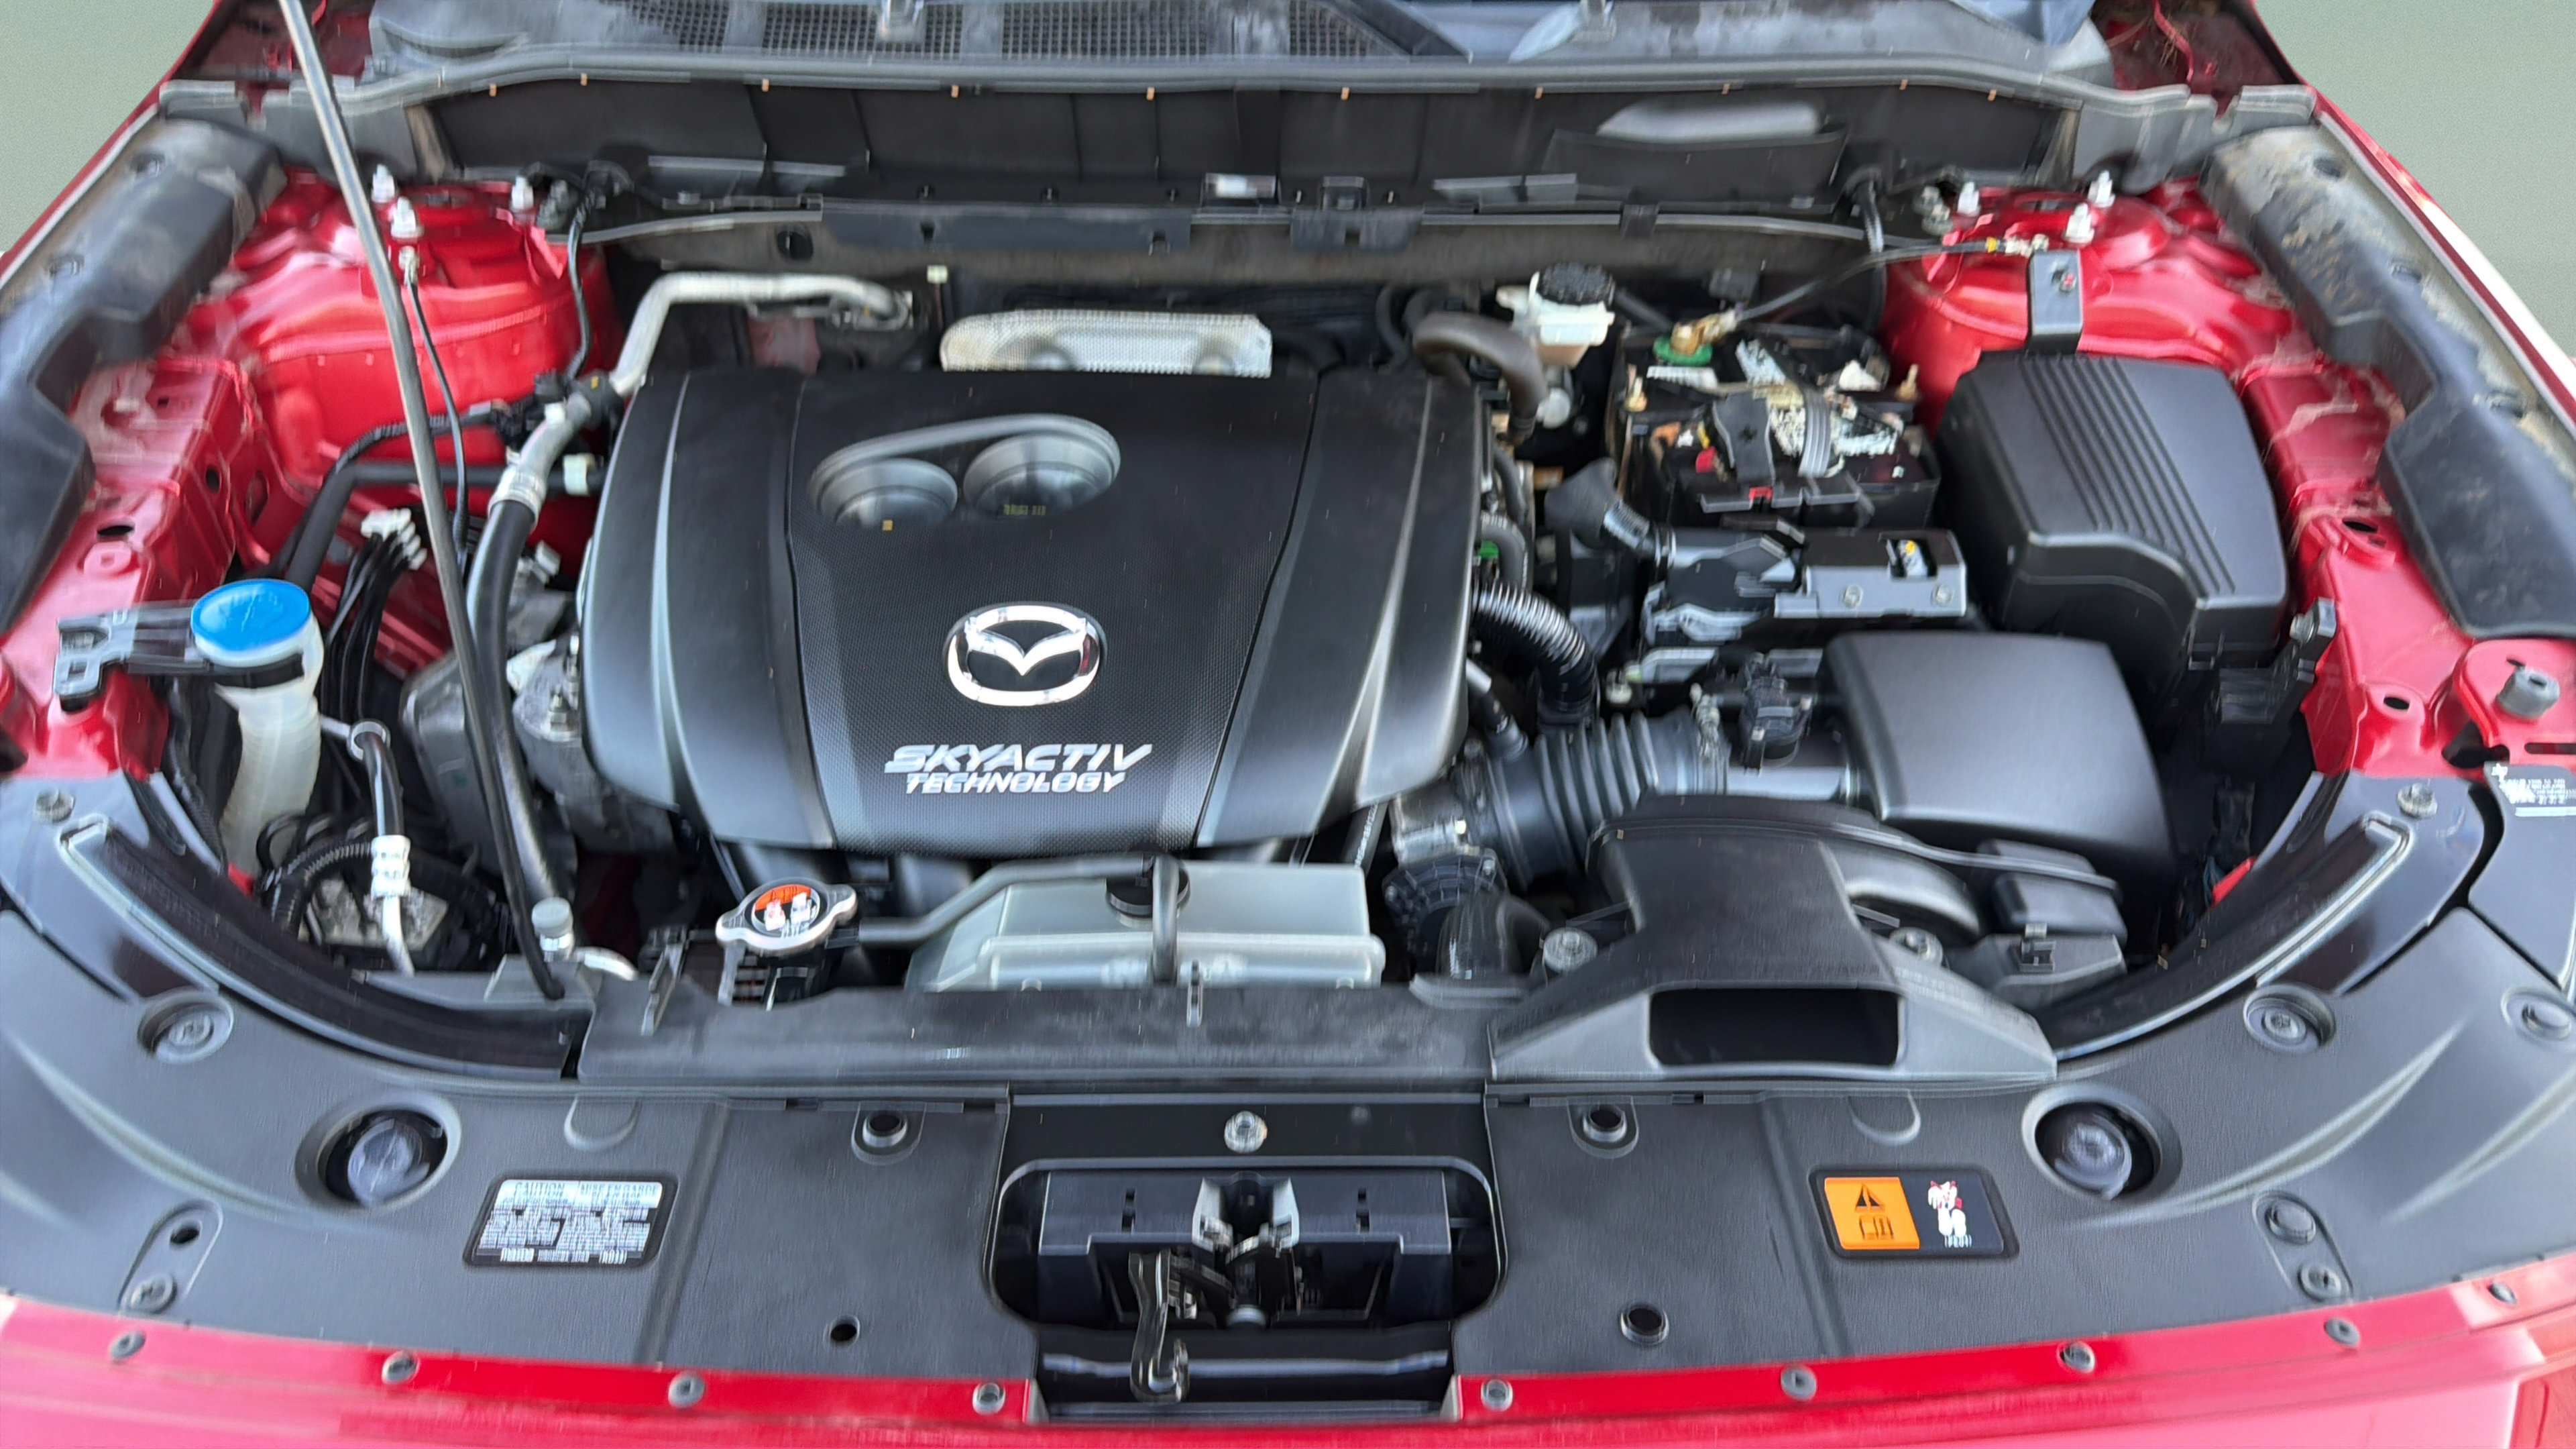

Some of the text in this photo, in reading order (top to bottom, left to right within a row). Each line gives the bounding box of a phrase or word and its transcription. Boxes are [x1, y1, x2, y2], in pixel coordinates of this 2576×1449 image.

[885, 743, 1152, 773] SKYACTIV
[906, 771, 1127, 794] TECHNOLOGY
[515, 1181, 565, 1192] CAUTION
